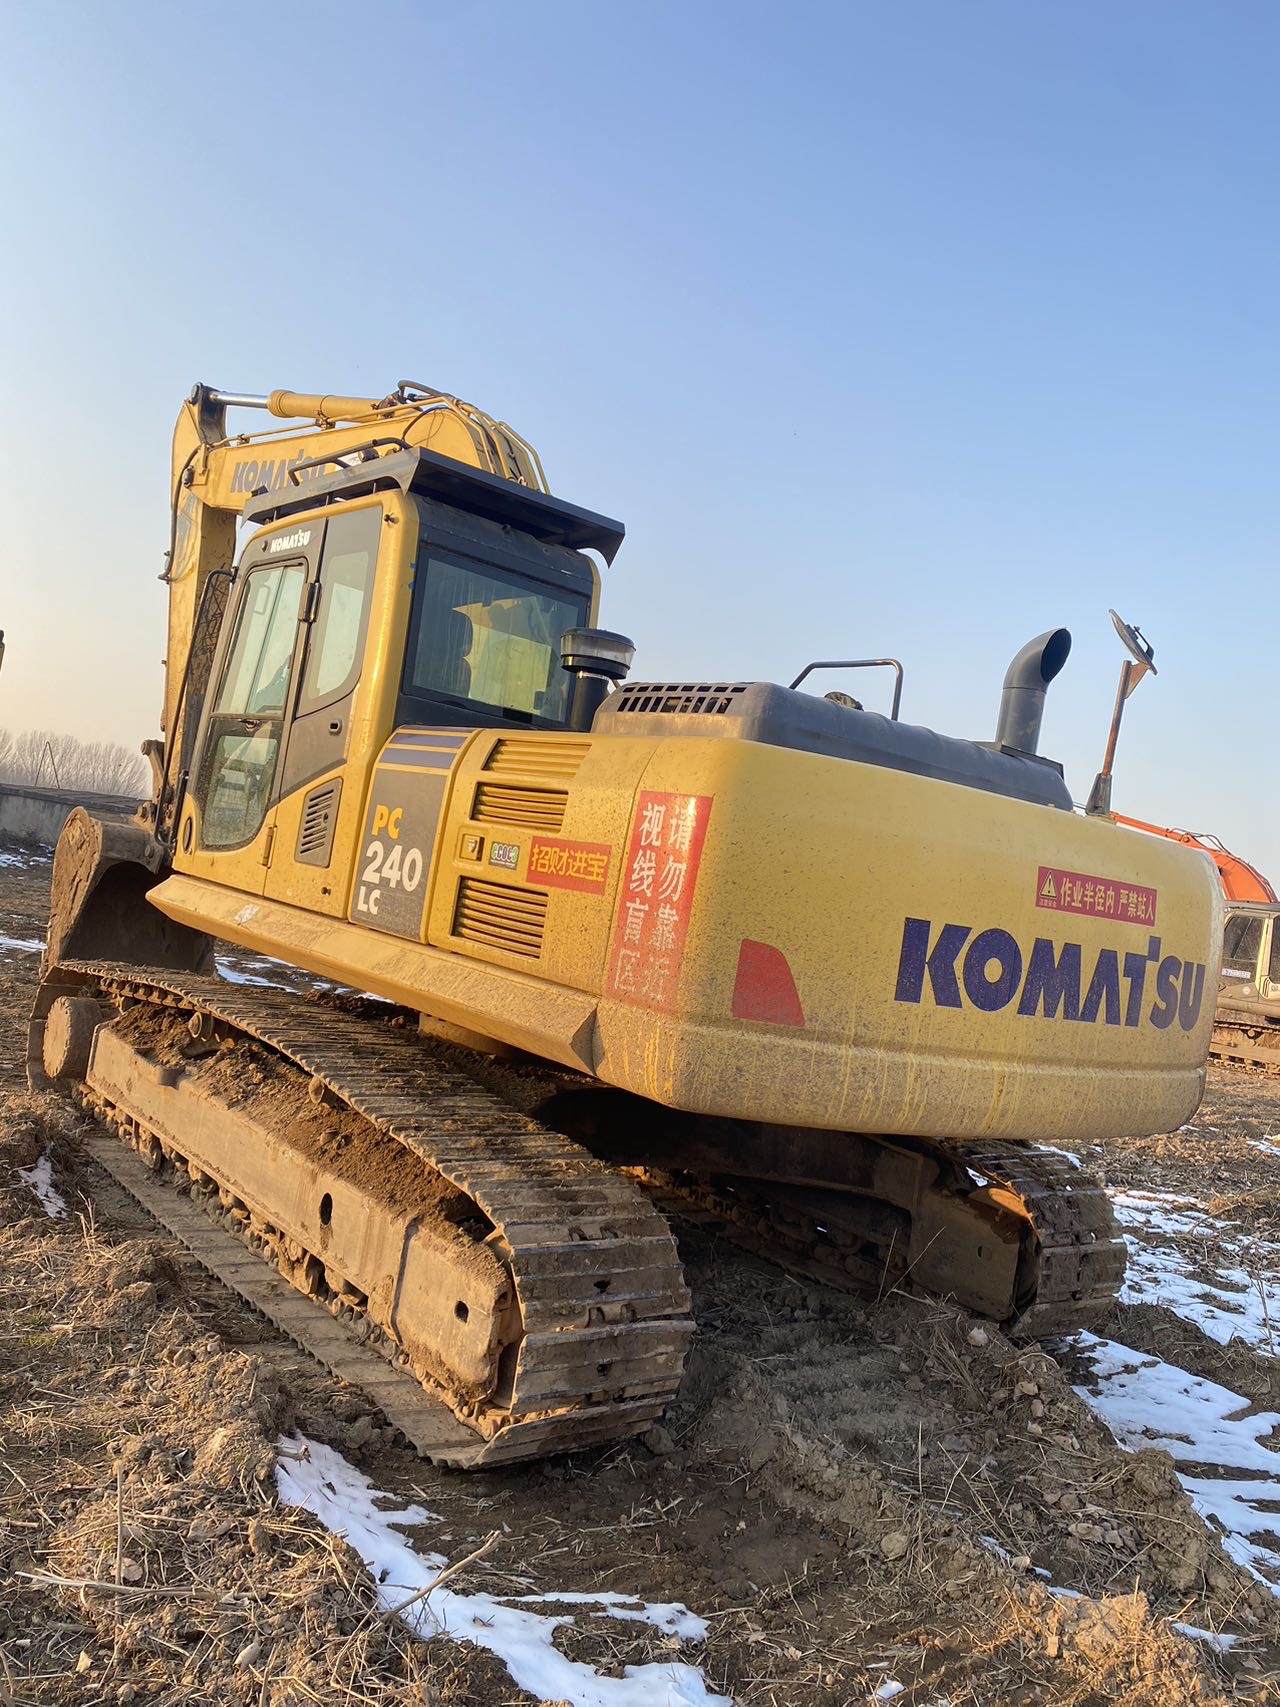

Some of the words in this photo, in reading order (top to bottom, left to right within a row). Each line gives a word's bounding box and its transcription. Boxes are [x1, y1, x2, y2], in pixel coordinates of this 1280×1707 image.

[270, 529, 311, 553] KOMATSU
[371, 804, 403, 839] PC
[361, 840, 423, 892] 240
[530, 844, 608, 882] 招财进宝
[357, 886, 381, 915] LC
[614, 802, 666, 993] 视线盲区
[1060, 878, 1115, 914] 作业半径内
[1118, 889, 1154, 920] 严禁站人
[894, 917, 1205, 1031] KOMATSU
